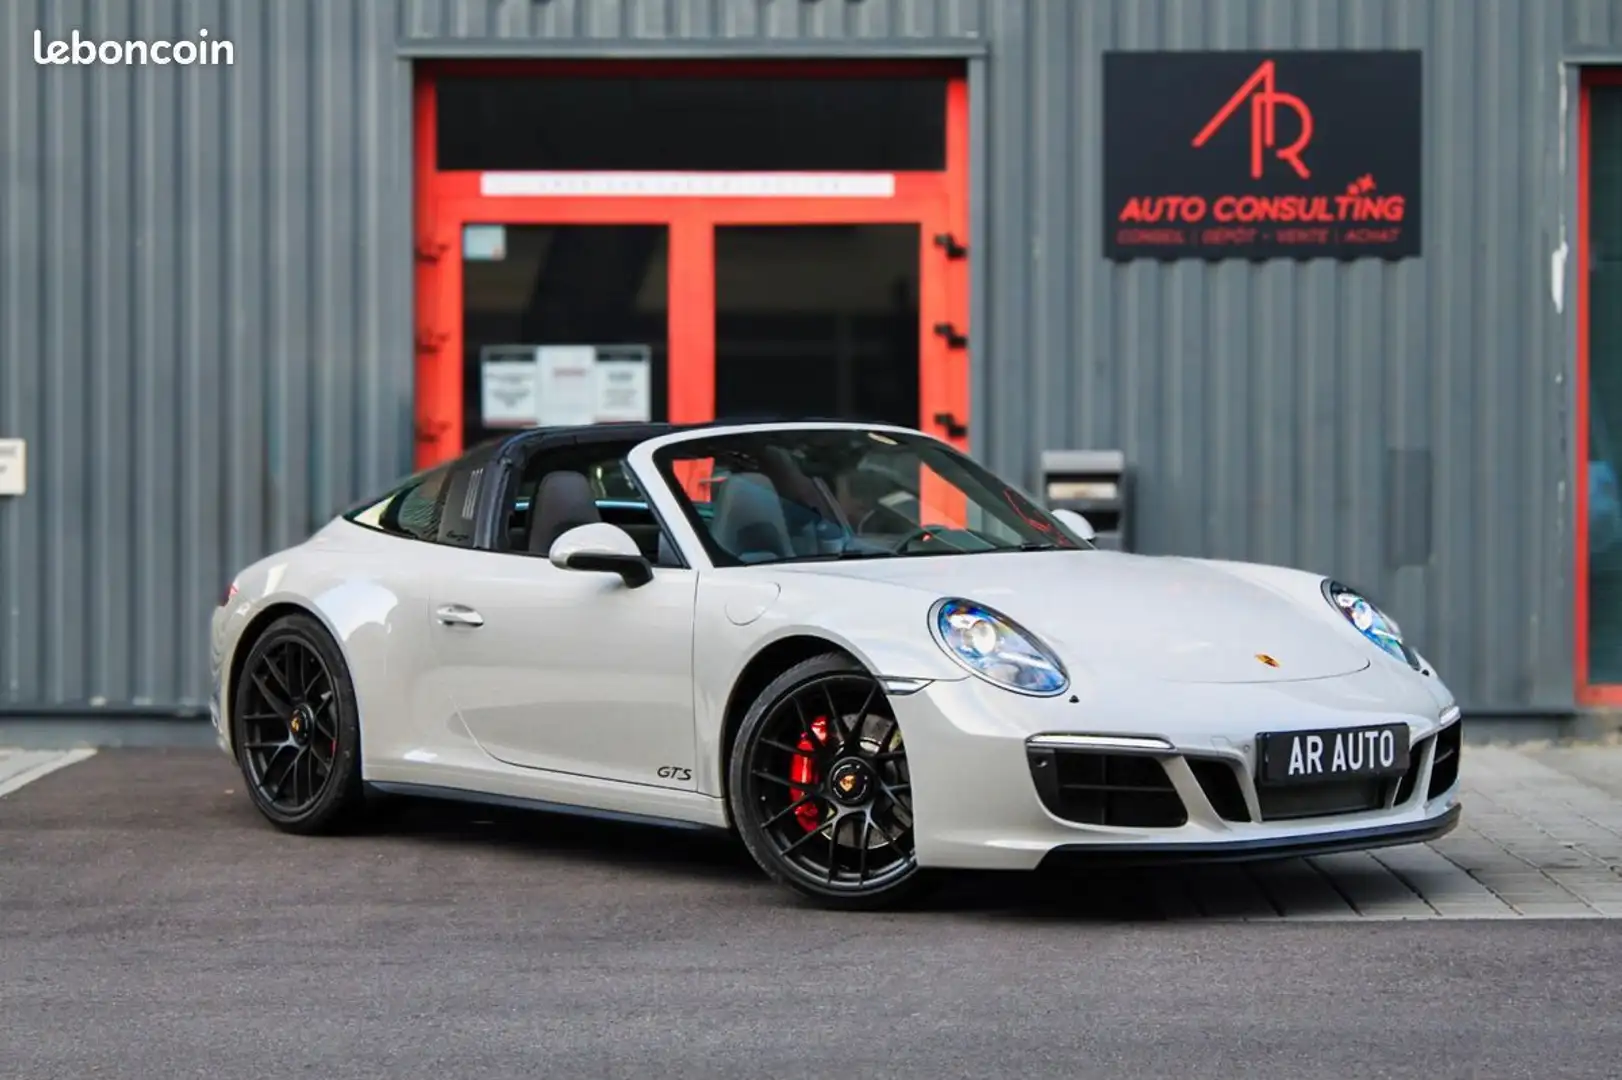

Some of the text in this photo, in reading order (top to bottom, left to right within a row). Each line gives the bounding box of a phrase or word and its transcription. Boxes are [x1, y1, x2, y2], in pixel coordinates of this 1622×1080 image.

[1118, 195, 1406, 222] AUTO CONSULTING
[1288, 730, 1394, 776] AR AUTO
[656, 765, 692, 781] GTS
